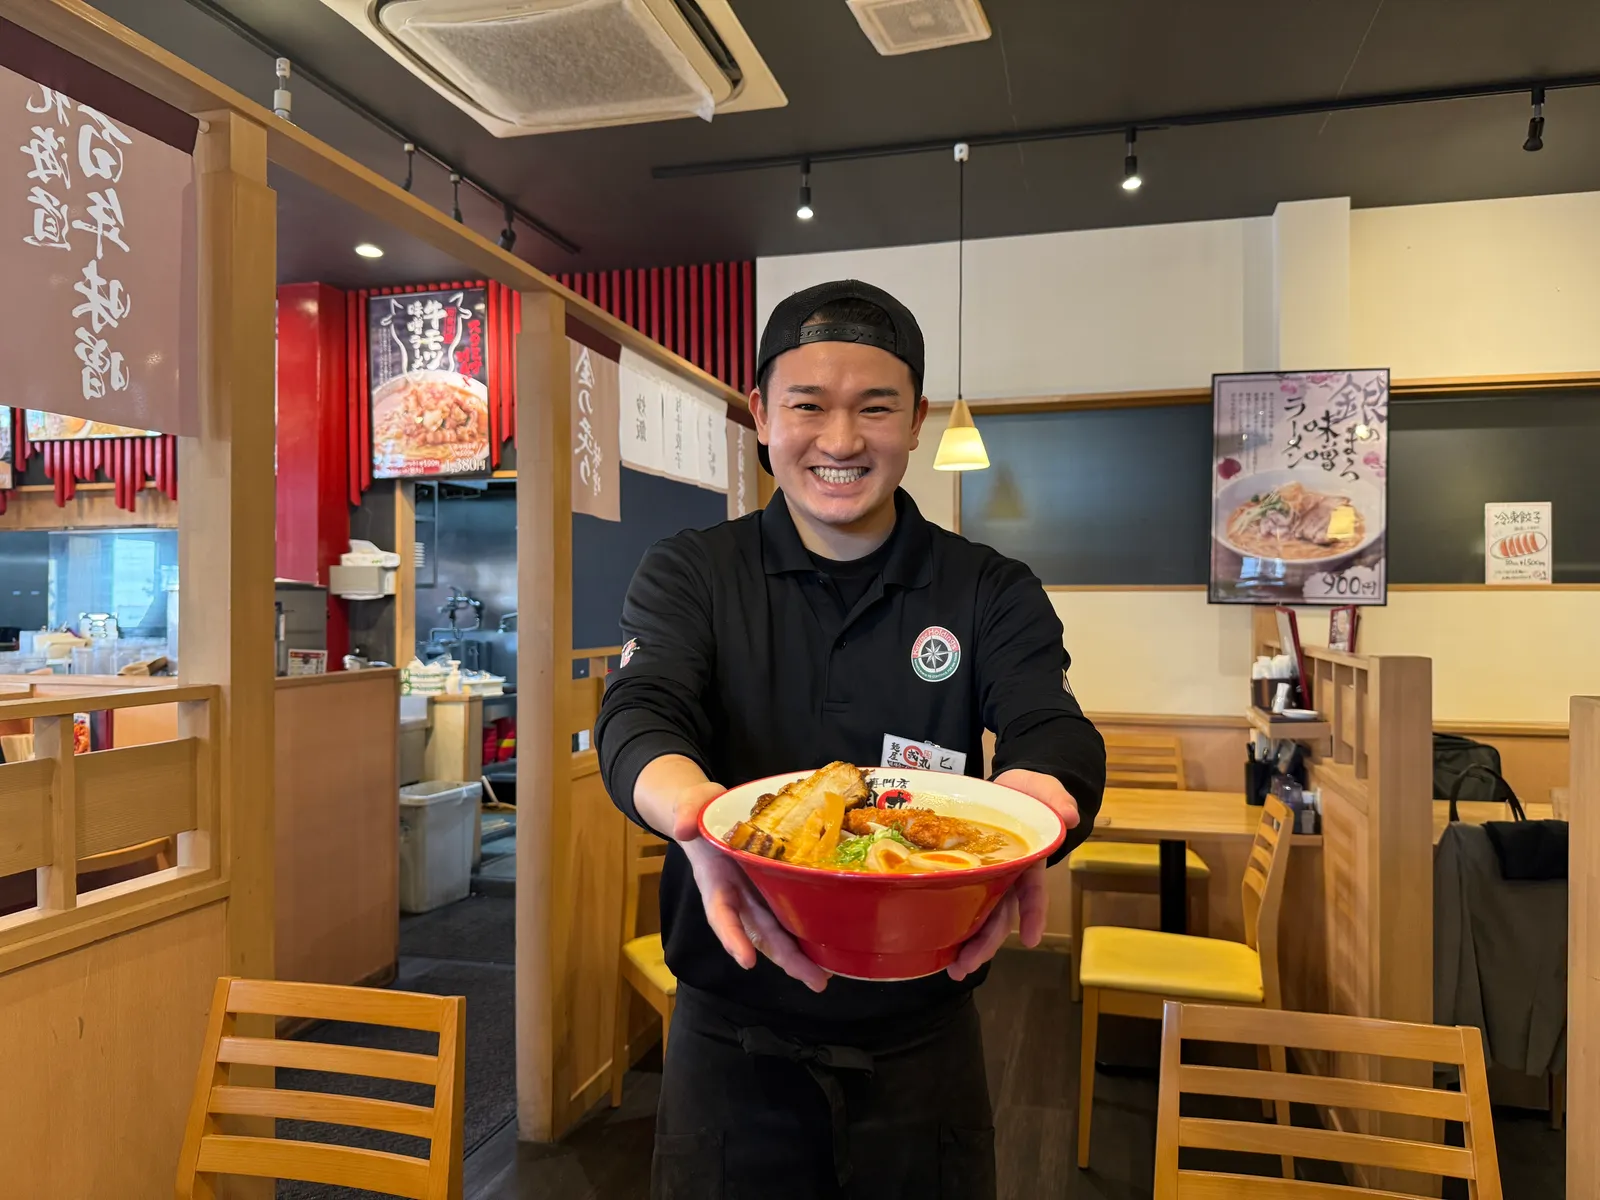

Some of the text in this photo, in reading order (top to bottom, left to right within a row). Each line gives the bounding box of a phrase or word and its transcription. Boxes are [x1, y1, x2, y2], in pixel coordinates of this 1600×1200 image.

[1282, 396, 1306, 469] ラーメン
[1304, 410, 1340, 471] 味噌
[1322, 574, 1376, 595] 900円
[928, 628, 957, 651] Holdings
